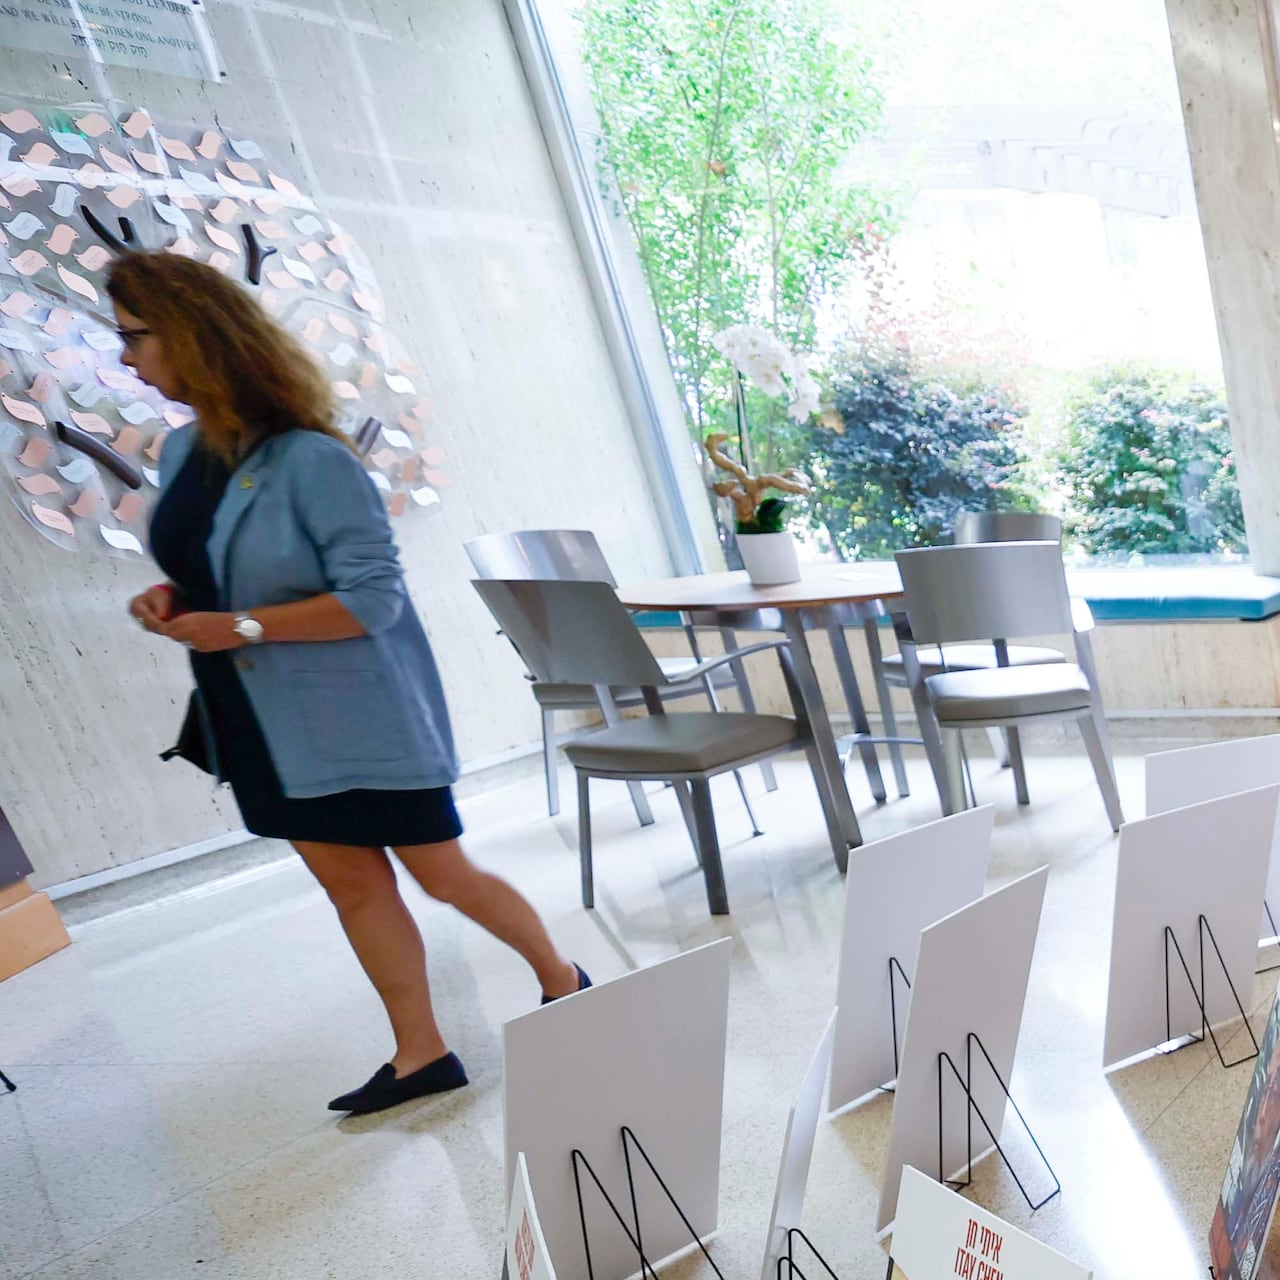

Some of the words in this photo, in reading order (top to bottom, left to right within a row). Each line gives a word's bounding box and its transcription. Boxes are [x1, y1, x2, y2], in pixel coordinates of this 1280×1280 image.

[115, 9, 153, 25] STRONG
[965, 1218, 979, 1250] חן
[980, 1226, 1003, 1265] איתי
